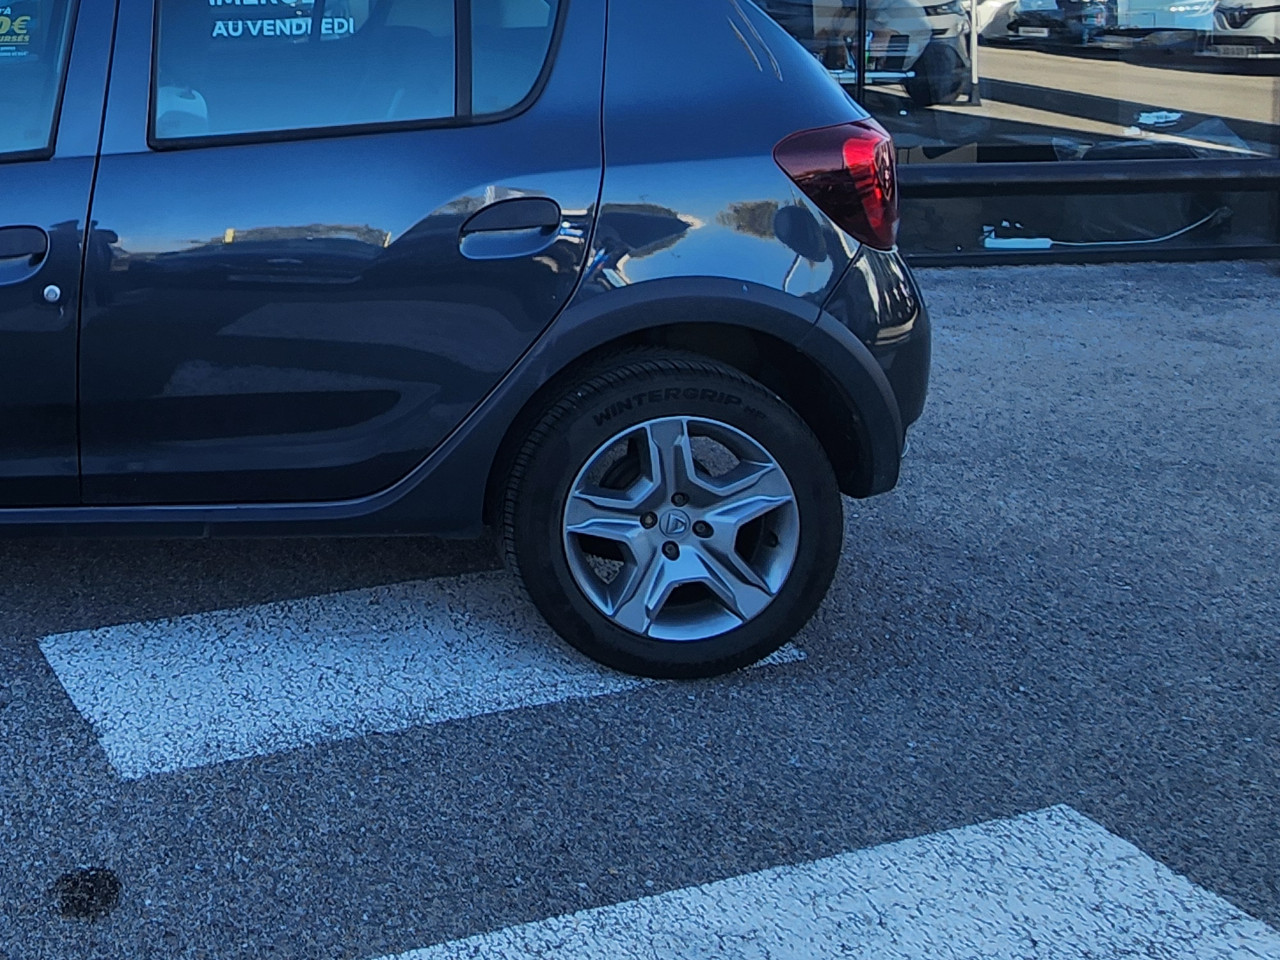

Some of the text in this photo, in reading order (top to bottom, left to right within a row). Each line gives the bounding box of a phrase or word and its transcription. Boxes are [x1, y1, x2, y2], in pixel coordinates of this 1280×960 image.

[212, 16, 355, 38] AU VENDEDI
[591, 386, 743, 427] WINTERGRIP
